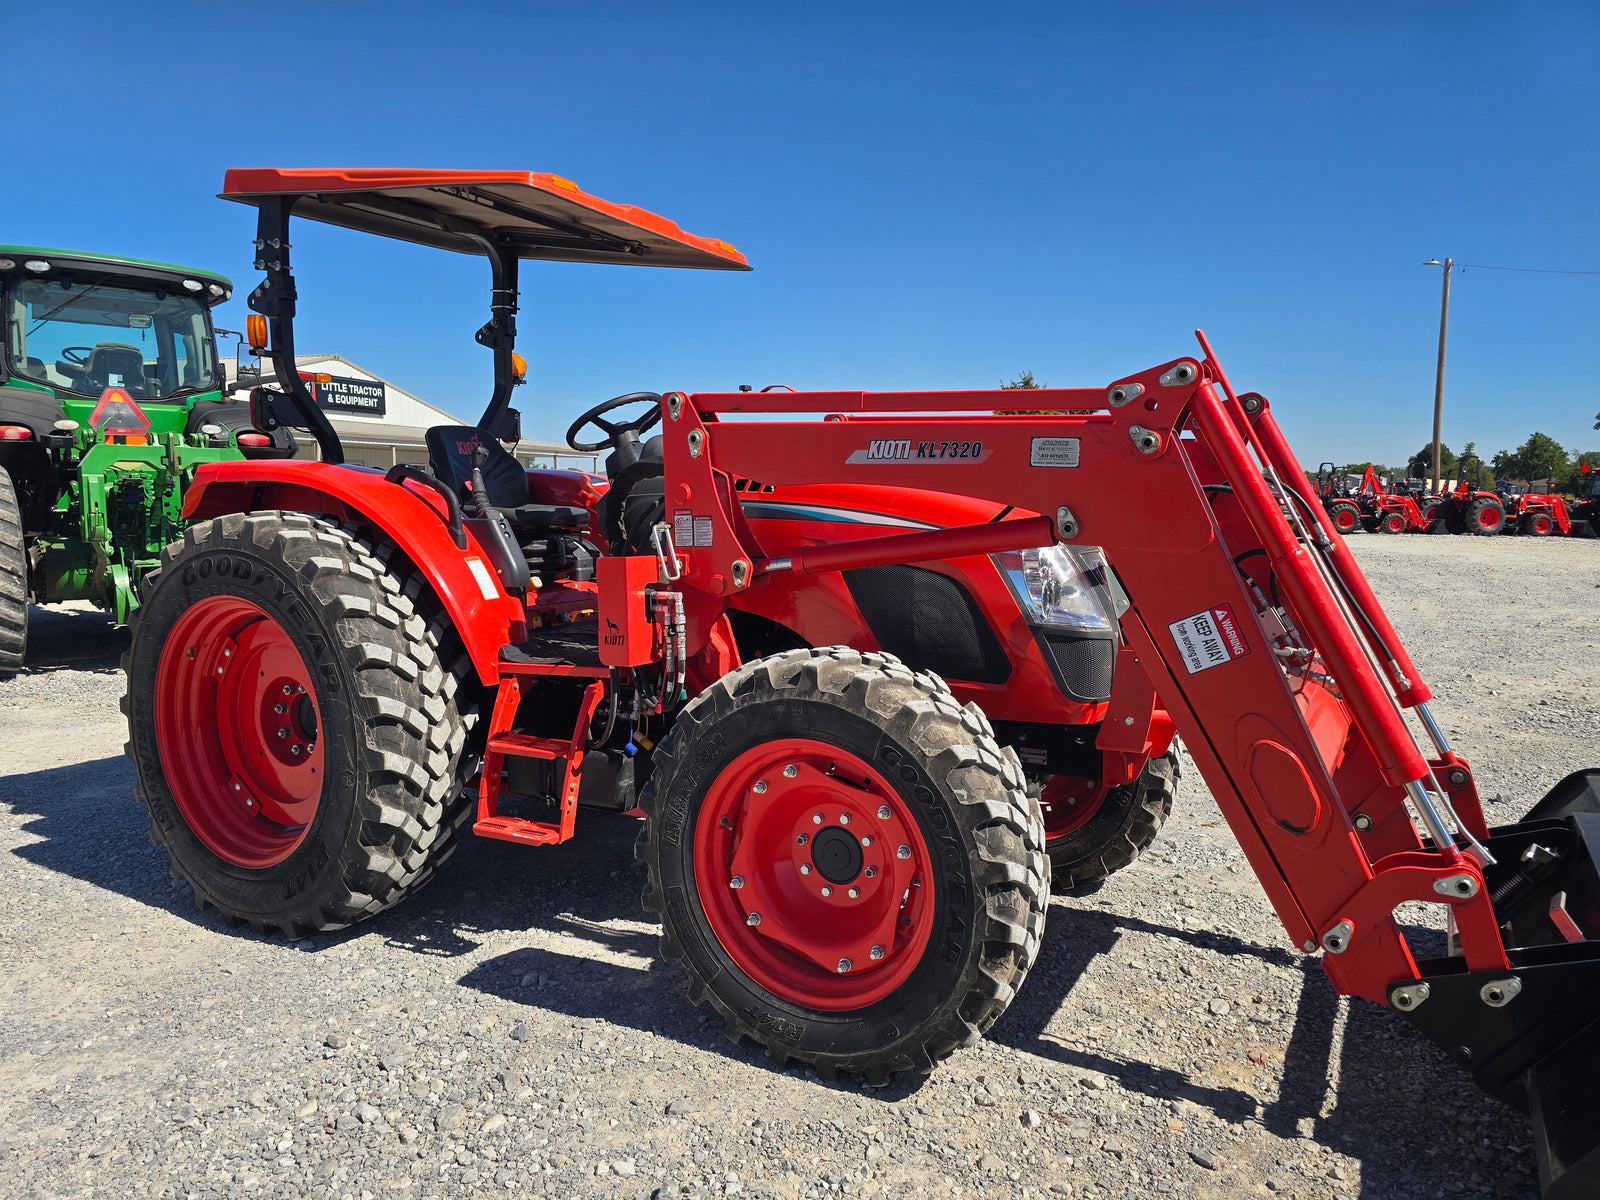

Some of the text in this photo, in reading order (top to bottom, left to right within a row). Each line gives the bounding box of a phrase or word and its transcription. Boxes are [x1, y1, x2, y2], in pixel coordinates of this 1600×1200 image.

[321, 382, 383, 398] LITTLE TRACTOR
[327, 393, 379, 408] & EQUIPMENT
[867, 439, 983, 460] KIOTI KL7320
[182, 555, 342, 692] GOODYEAR
[603, 634, 625, 647] KIOTI
[1191, 614, 1225, 663] KEEP AWAY
[1221, 618, 1245, 656] WARNING
[1175, 622, 1203, 670] from working area
[880, 745, 967, 967] GOODYEAR
